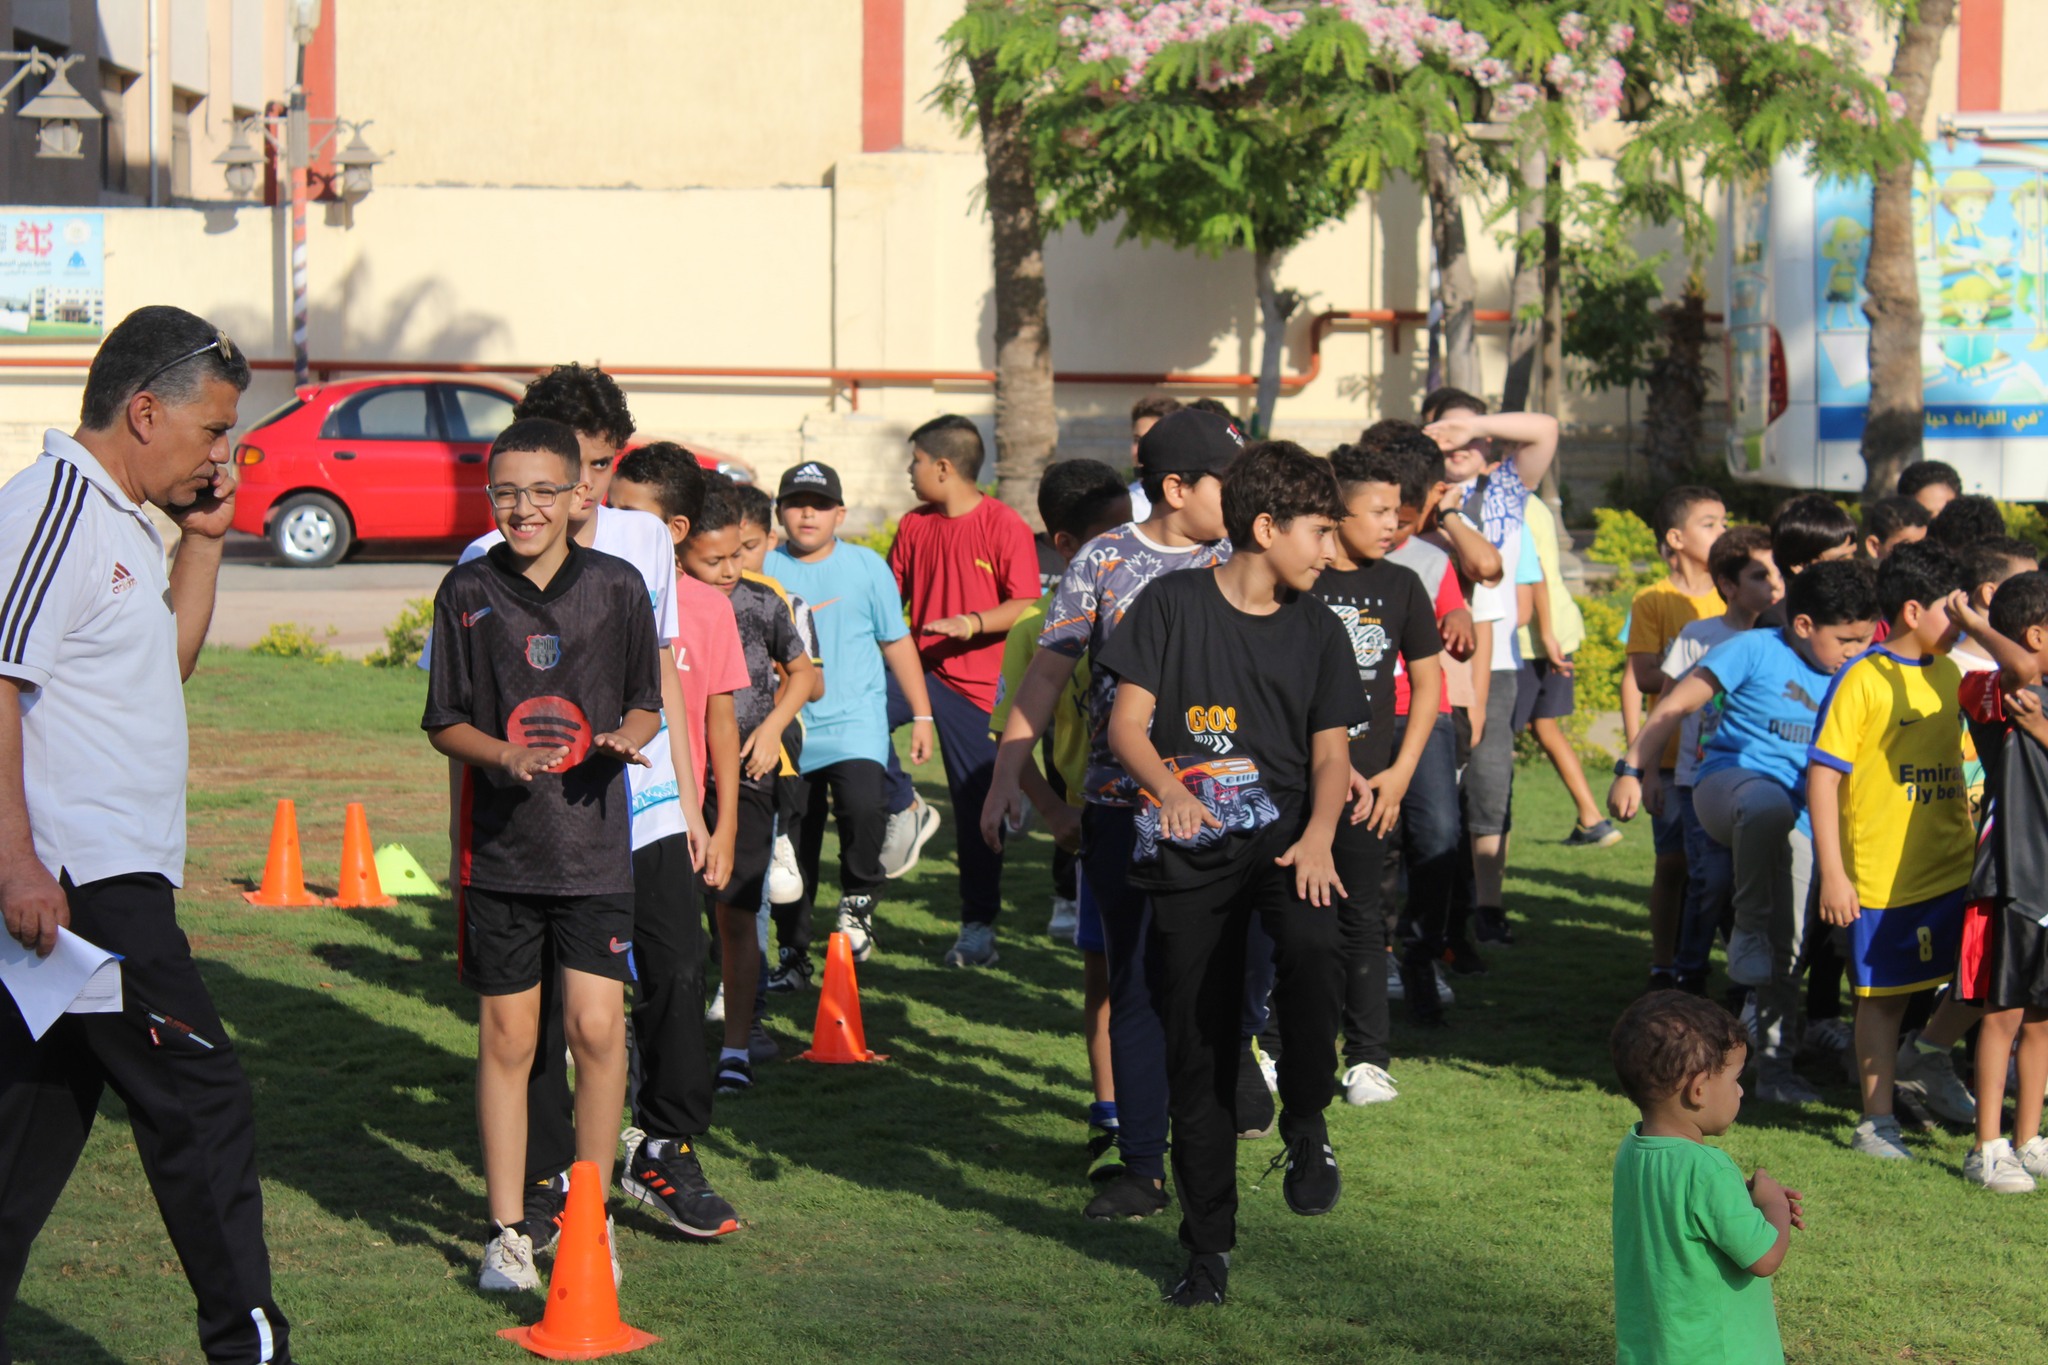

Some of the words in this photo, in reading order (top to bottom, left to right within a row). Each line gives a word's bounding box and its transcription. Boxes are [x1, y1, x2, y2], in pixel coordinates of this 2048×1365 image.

[1926, 410, 1948, 429] حيا
[1185, 705, 1238, 735] GO!
[1768, 719, 1811, 743] PUM
[1900, 762, 1962, 783] Emira
[1907, 785, 1933, 805] fly
[1917, 926, 1933, 962] 8
